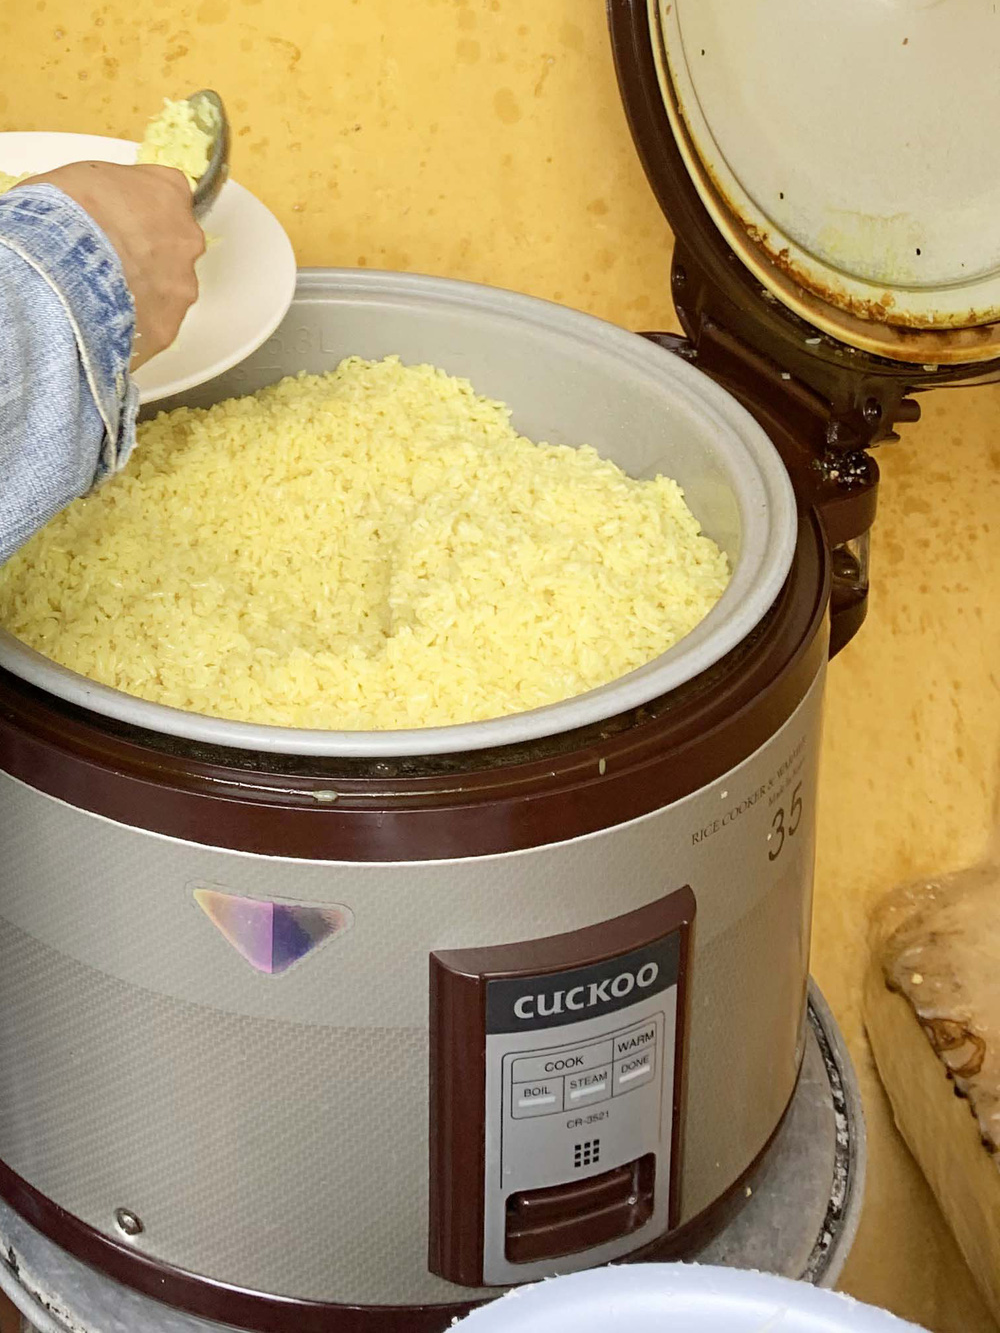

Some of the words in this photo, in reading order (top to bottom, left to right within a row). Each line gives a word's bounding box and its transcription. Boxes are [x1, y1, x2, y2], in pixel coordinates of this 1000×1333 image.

[691, 819, 721, 846] RICE
[721, 784, 766, 827] COOKER
[768, 780, 803, 862] 35
[513, 961, 660, 1020] CUCKOO
[523, 1086, 551, 1098] BOIL
[569, 1071, 608, 1089] STEAM
[620, 1054, 650, 1074] DONE
[544, 1056, 585, 1073] COOK
[617, 1029, 655, 1053] WARM
